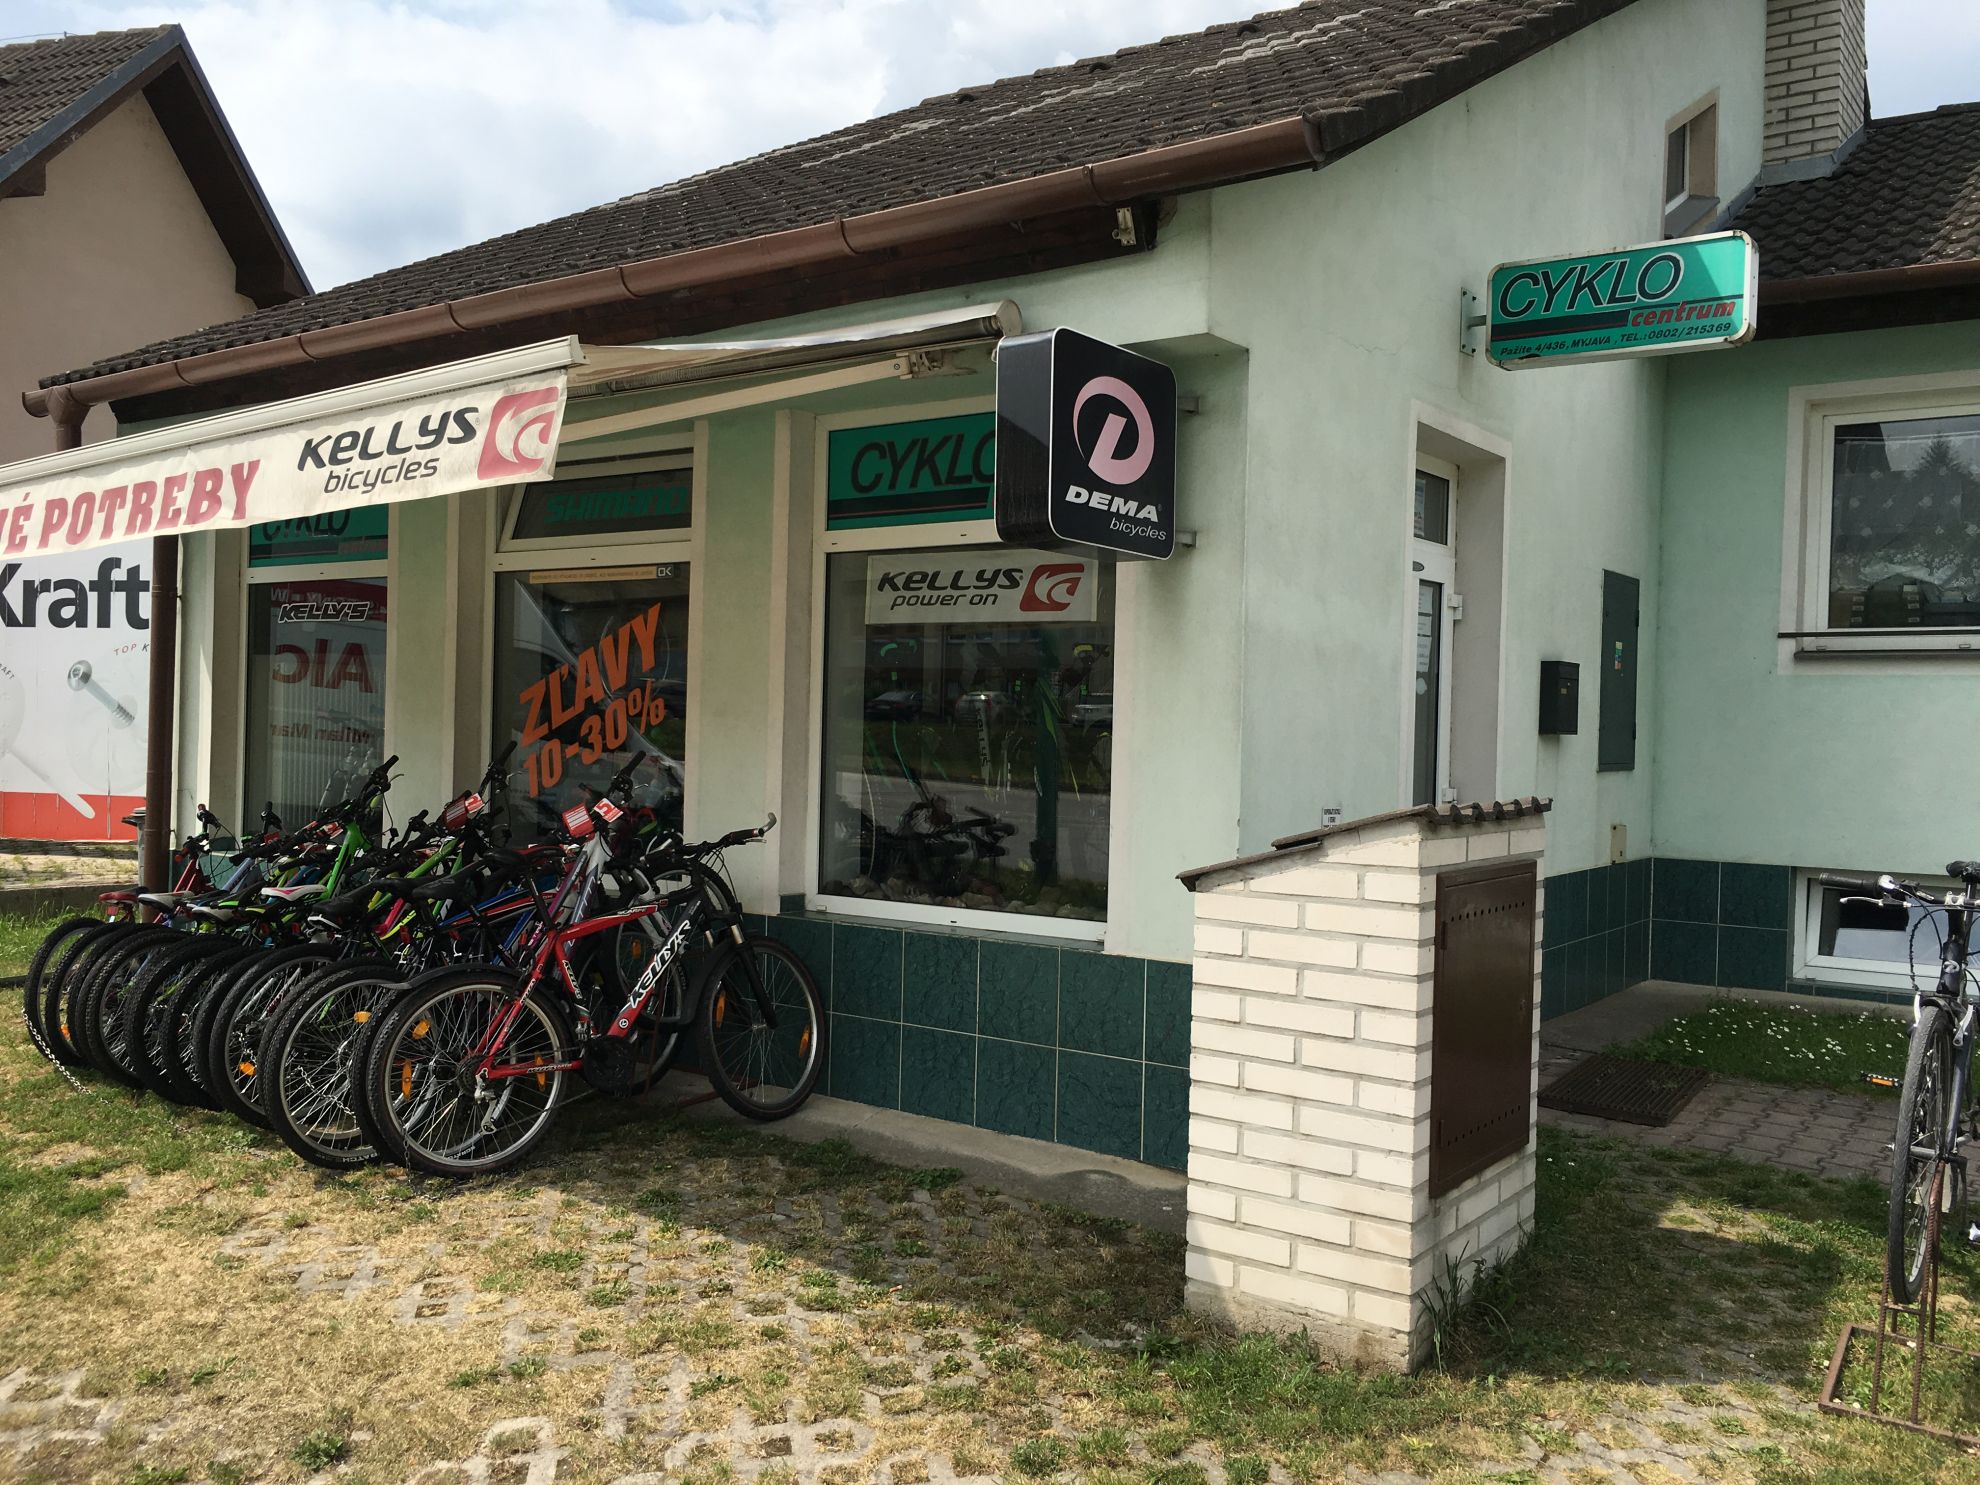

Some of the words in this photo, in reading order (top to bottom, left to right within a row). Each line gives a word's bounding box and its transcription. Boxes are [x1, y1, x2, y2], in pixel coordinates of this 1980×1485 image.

[1500, 252, 1684, 319] CYKLO
[1632, 300, 1735, 327] centrum
[1500, 344, 1532, 356] Pažite
[323, 457, 441, 495] bicycles
[37, 458, 261, 550] POTREBY
[544, 486, 689, 523] SHIMANO
[1065, 485, 1159, 523] DEMA
[1109, 516, 1167, 541] bicycles
[278, 601, 371, 624] KELLY'S
[890, 593, 967, 611] power
[969, 593, 999, 607] on
[114, 643, 137, 656] TOP
[522, 679, 666, 799] 10-30%
